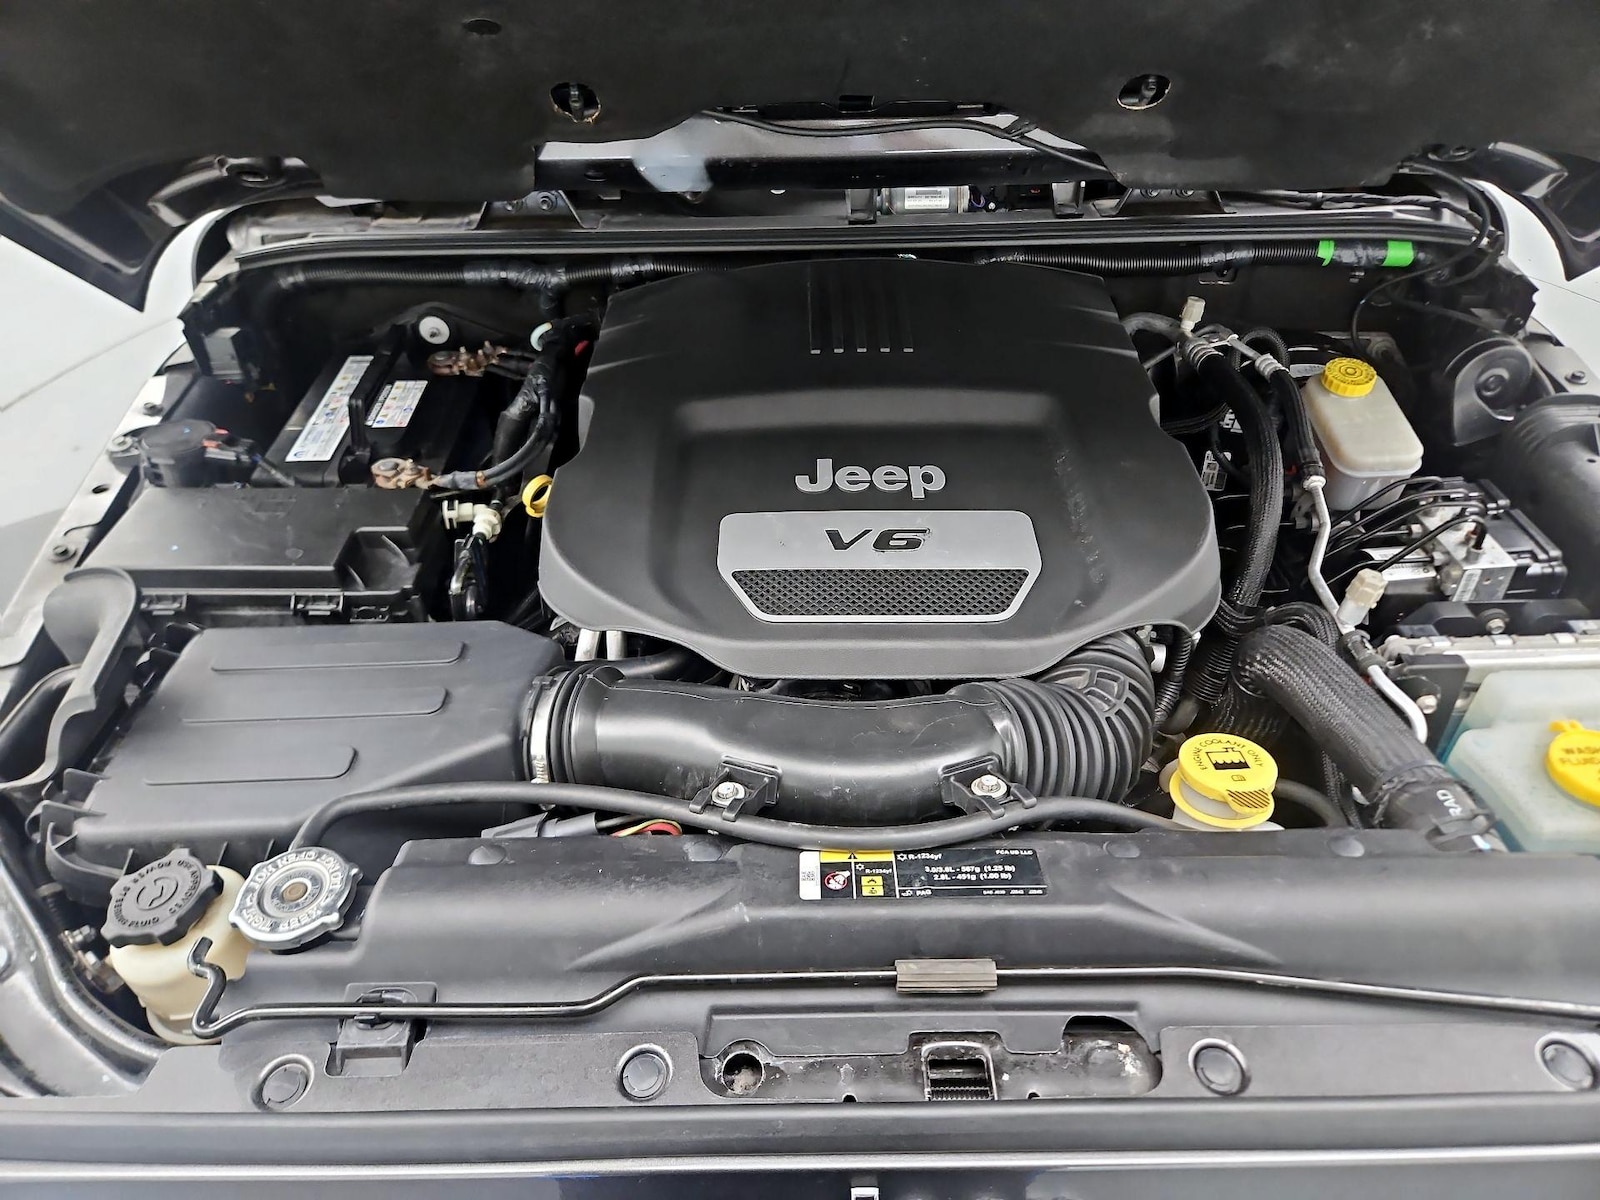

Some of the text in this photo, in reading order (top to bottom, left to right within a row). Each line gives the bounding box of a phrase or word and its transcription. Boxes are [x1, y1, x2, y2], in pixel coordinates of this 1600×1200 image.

[795, 458, 946, 499] Jeep
[824, 528, 930, 551] V6
[1192, 738, 1264, 771] ENGINE COOLANT ONLY
[1436, 789, 1463, 817] RAD
[908, 853, 942, 861] R-1234yf
[133, 860, 172, 883] POWER
[984, 865, 1003, 873] (1.25
